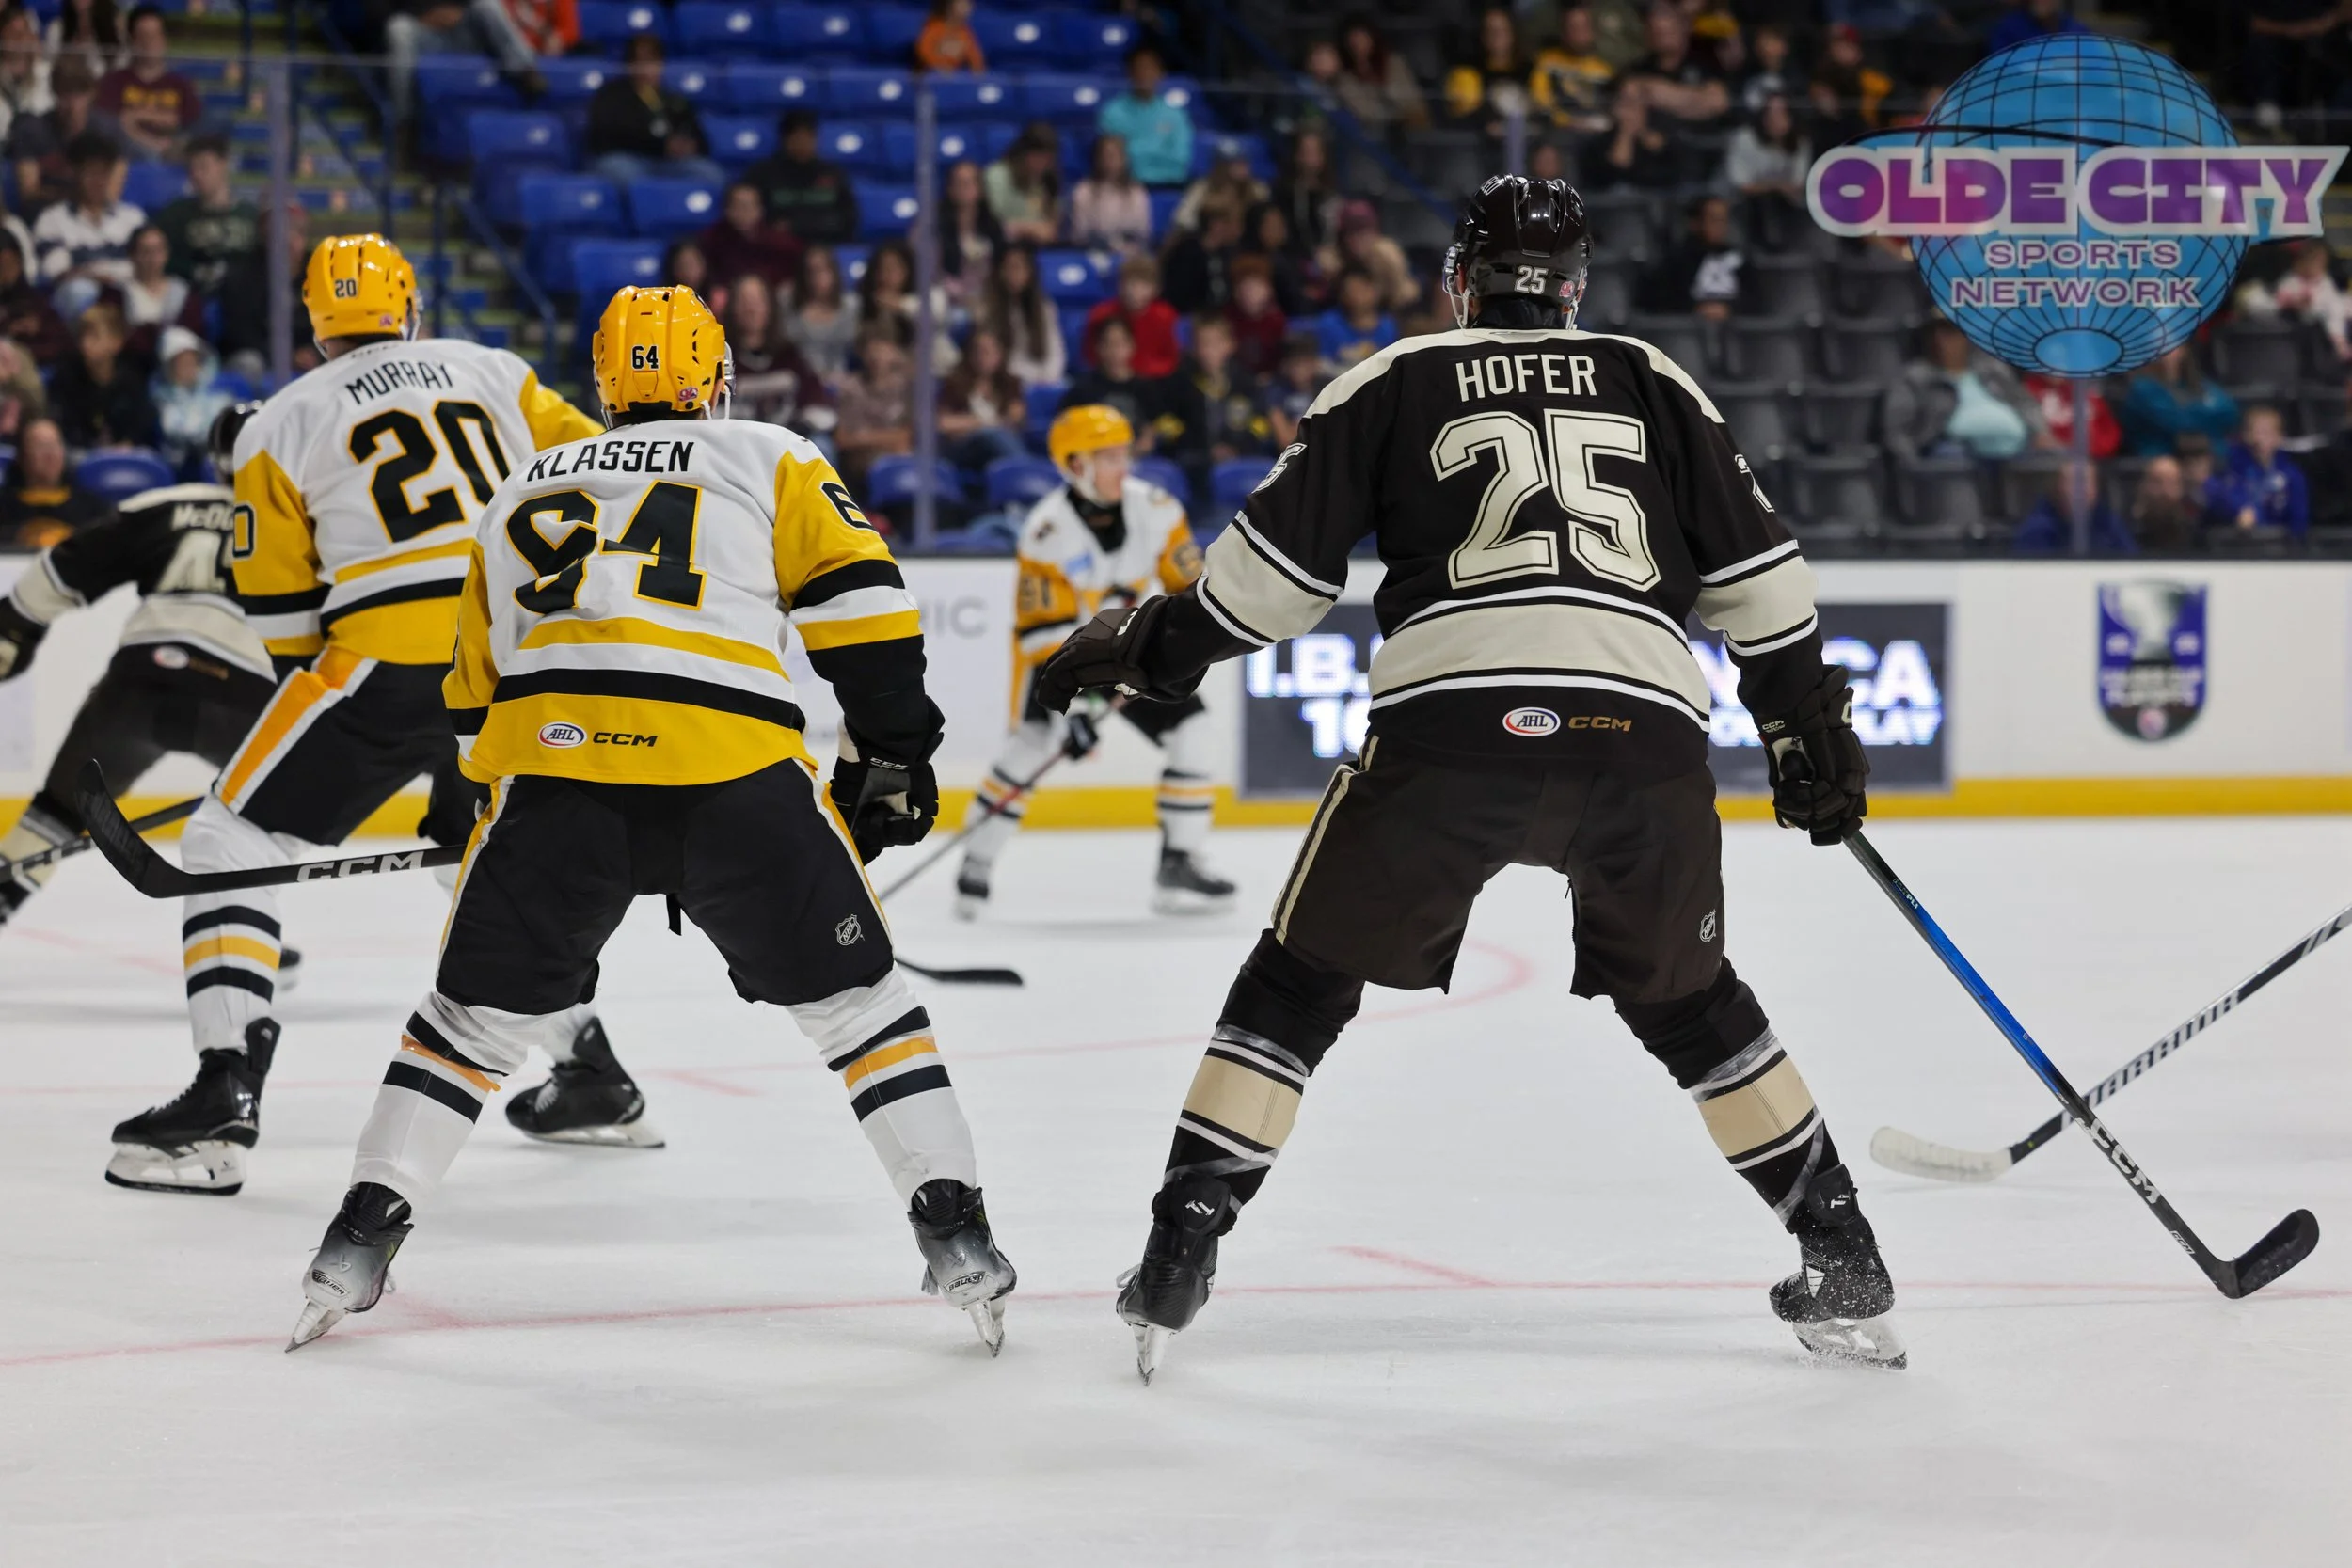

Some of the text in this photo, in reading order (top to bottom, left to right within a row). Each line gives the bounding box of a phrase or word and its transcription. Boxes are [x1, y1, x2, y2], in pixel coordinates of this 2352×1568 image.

[335, 279, 357, 298] 20
[1515, 265, 1549, 294] 25
[631, 345, 659, 370] 64
[345, 360, 453, 405] MURRAY
[1455, 354, 1597, 403] HOFER
[348, 399, 513, 544] 20
[526, 440, 695, 483] KLASSEN
[1429, 408, 1662, 592] 25
[547, 728, 658, 747] AHL CCM
[1516, 715, 1632, 732] AHL CCM
[296, 850, 424, 882] CCM
[2088, 1117, 2161, 1205] CCM
[2171, 1230, 2195, 1255] CCM
